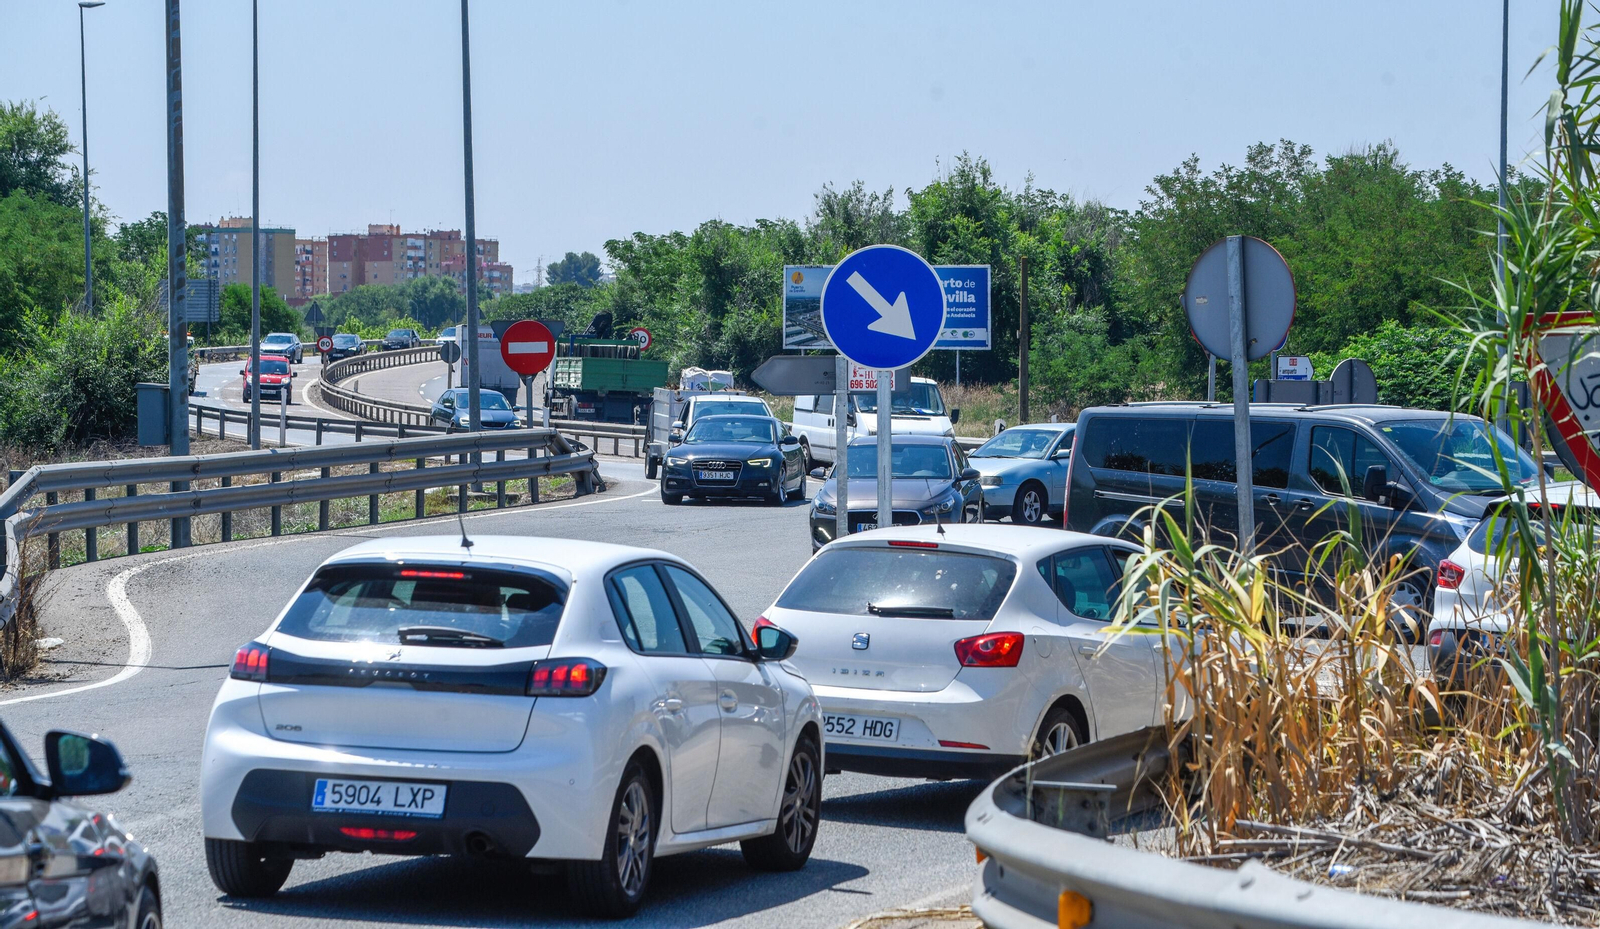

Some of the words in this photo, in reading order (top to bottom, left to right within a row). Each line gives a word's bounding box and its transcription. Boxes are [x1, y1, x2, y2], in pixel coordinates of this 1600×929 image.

[940, 278, 962, 288] rto
[964, 279, 975, 288] de
[946, 290, 976, 302] villa
[850, 380, 863, 389] 696
[863, 720, 894, 738] HDG
[331, 784, 382, 806] 5904
[394, 786, 435, 809] LXP
